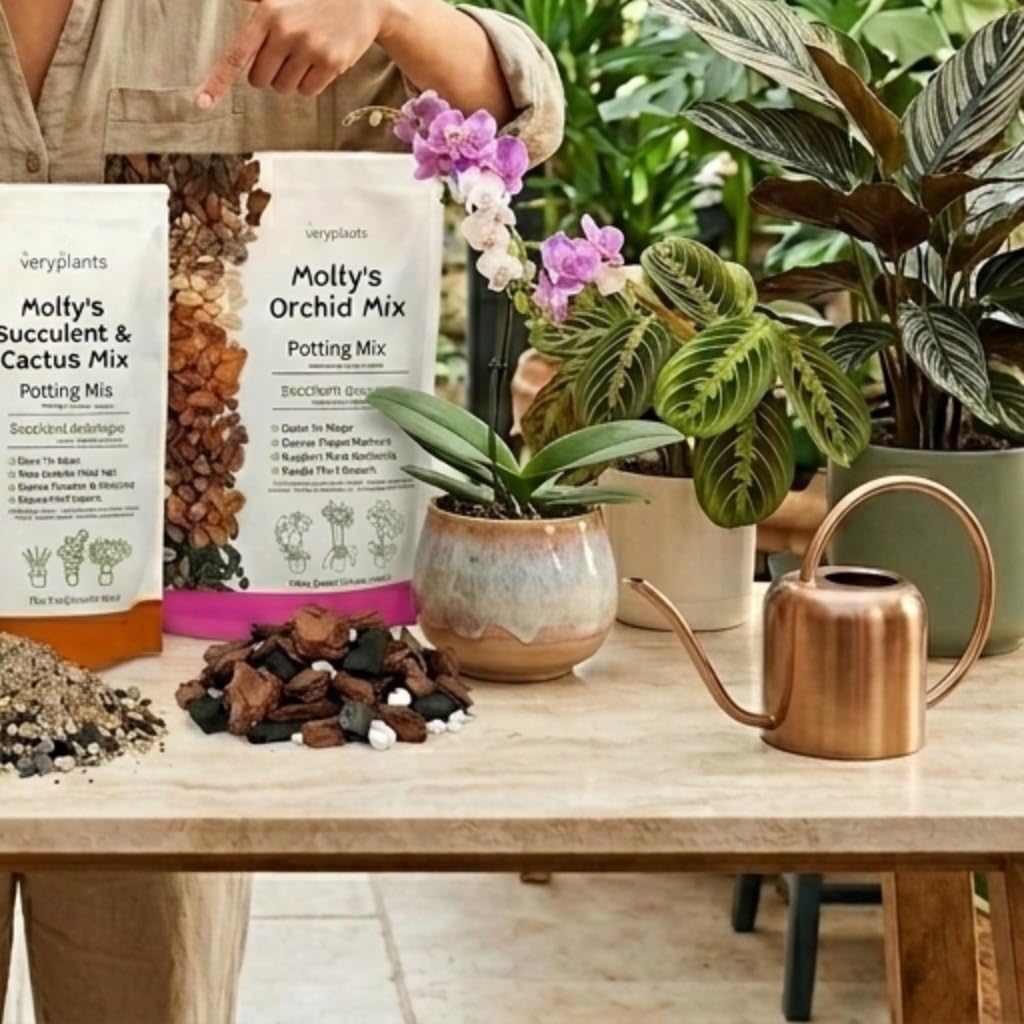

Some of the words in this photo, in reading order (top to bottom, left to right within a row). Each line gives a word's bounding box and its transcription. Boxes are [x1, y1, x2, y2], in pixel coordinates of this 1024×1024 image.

[19, 251, 109, 273] veryplants
[269, 293, 353, 319] Orchid
[362, 294, 406, 318] Mix
[114, 324, 132, 343] &
[0, 349, 81, 370] Cactus
[88, 348, 129, 369] Mix
[287, 339, 352, 361] Potting
[355, 339, 387, 357] Mix
[19, 382, 81, 403] Potting
